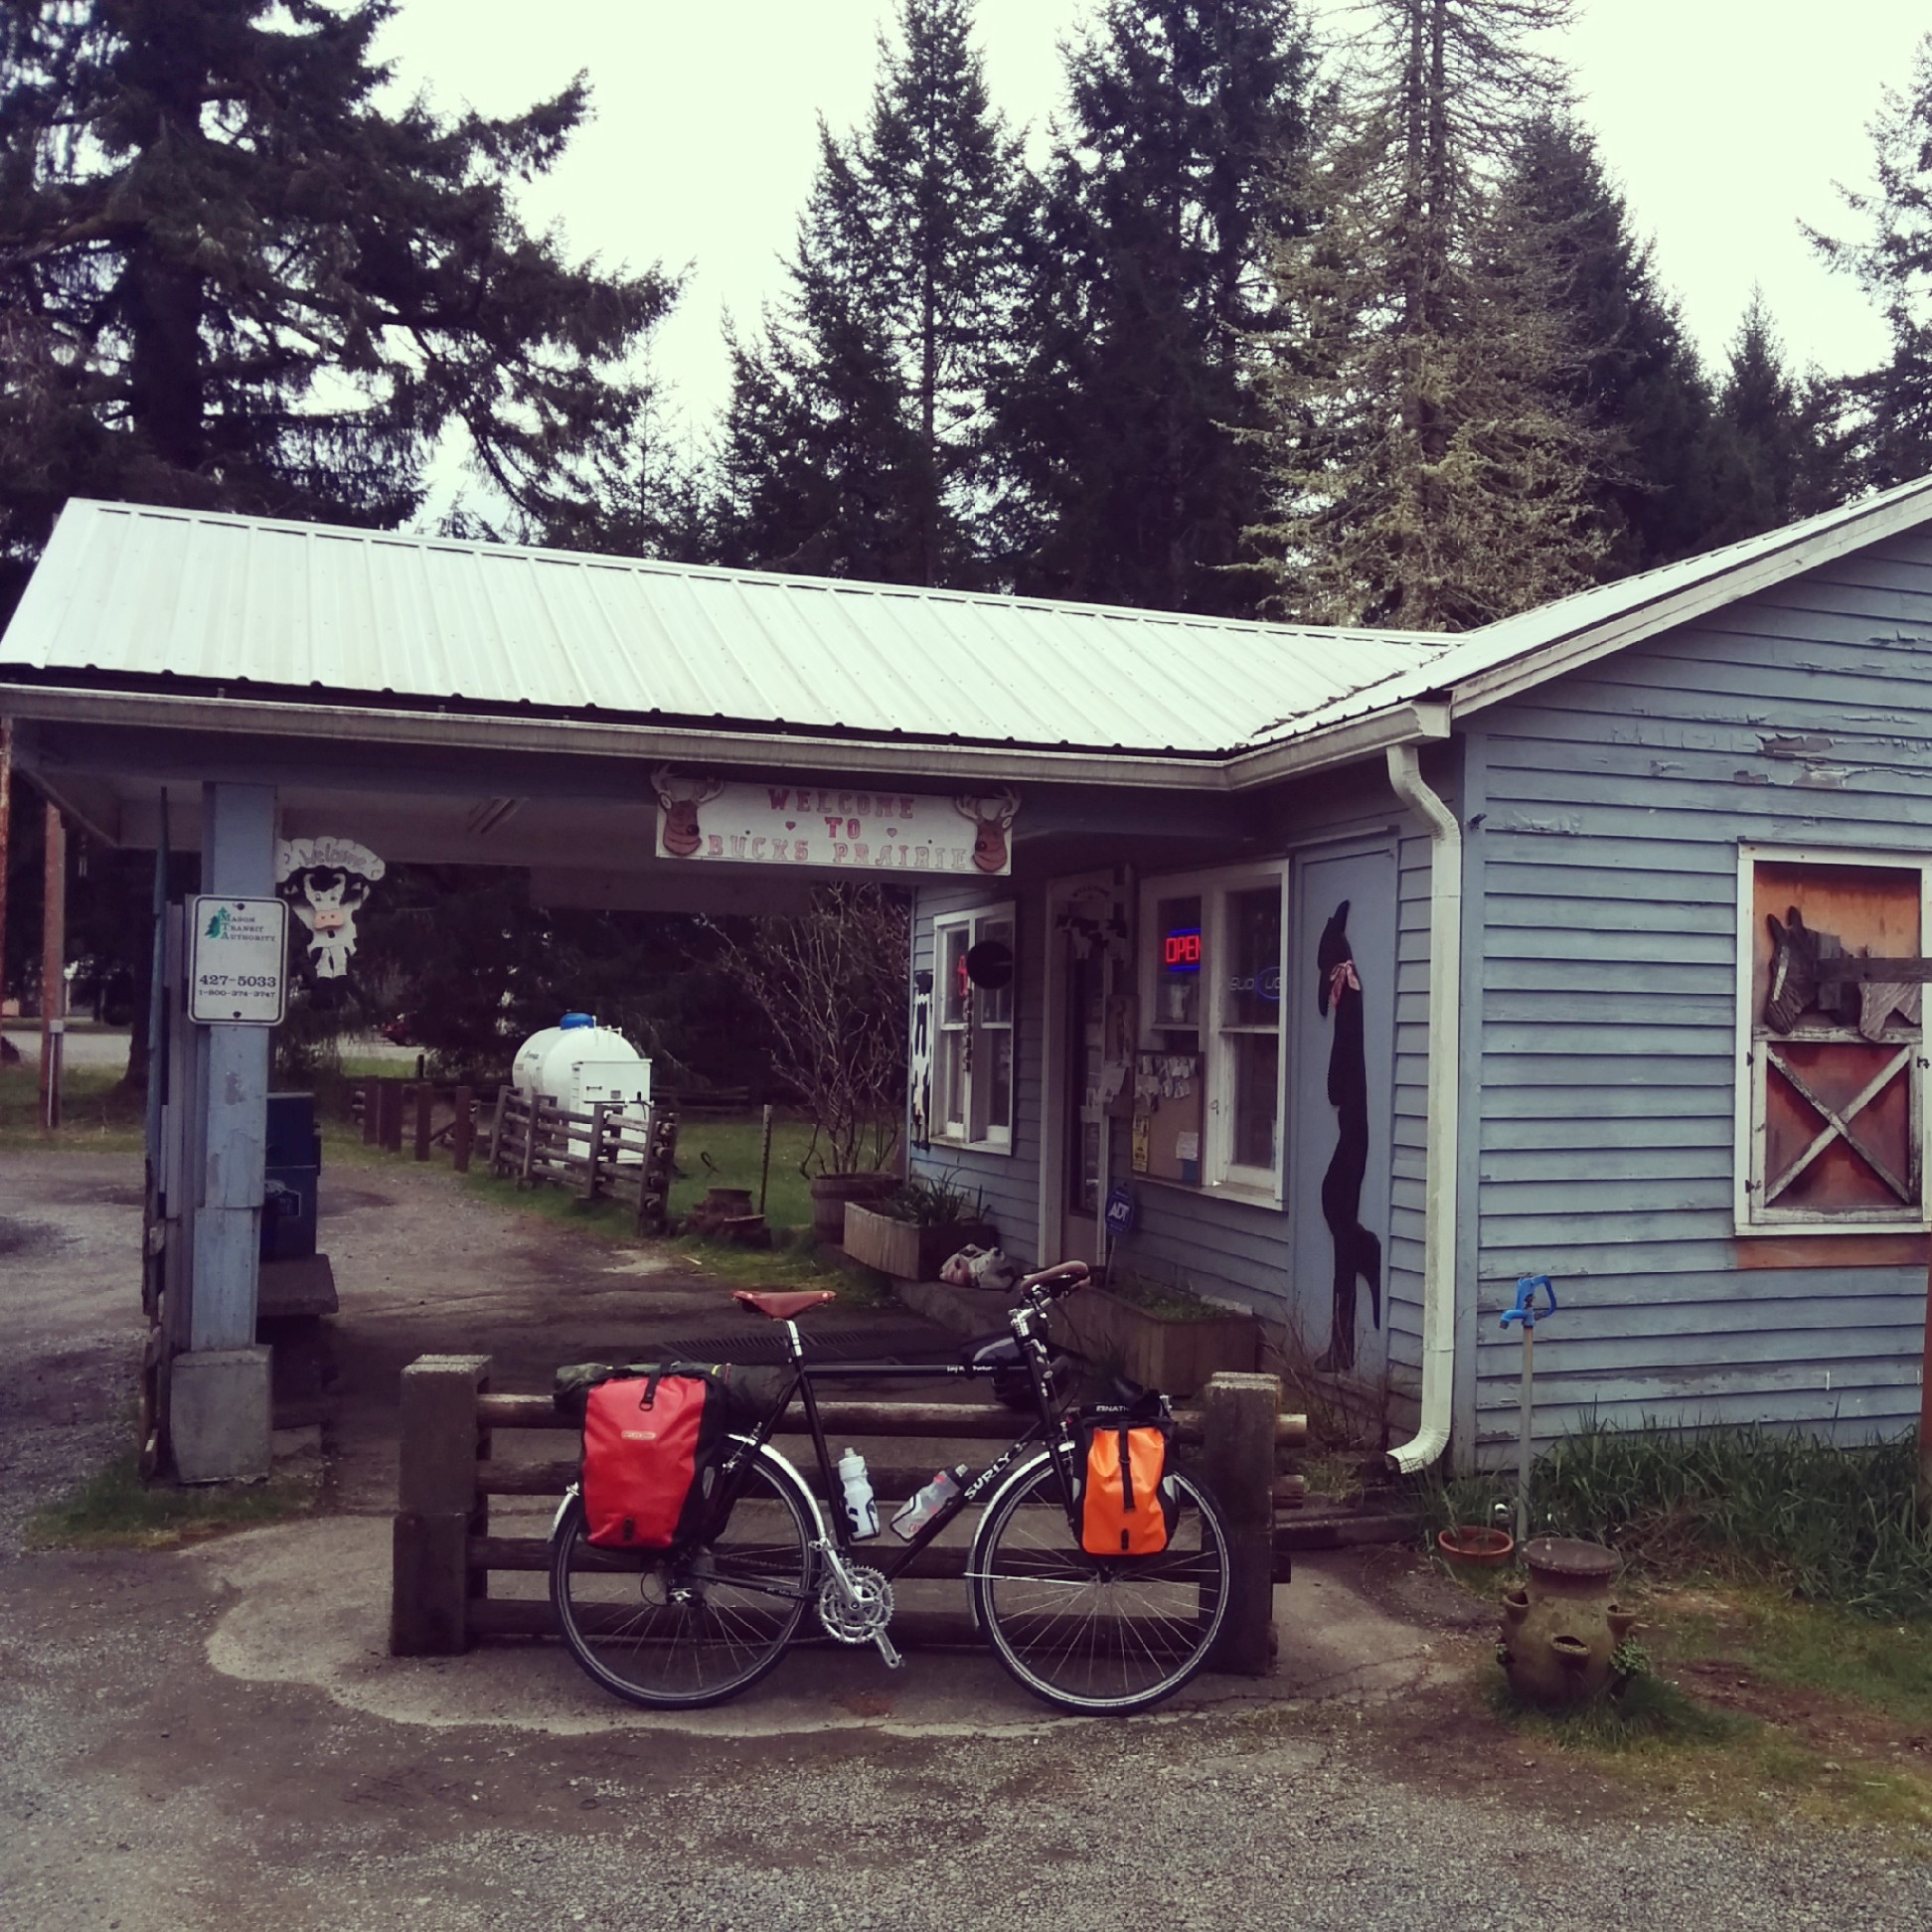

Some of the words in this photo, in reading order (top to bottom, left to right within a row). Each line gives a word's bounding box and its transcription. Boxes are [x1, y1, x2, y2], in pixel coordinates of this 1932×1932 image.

[768, 788, 914, 820] WELCOME
[824, 816, 862, 840] TO
[707, 834, 810, 862] BUCKS
[833, 842, 968, 871] PRAIRIE
[199, 974, 277, 988] 427-5033
[1107, 1201, 1130, 1222] ADT
[964, 1451, 1011, 1501] SURLY
